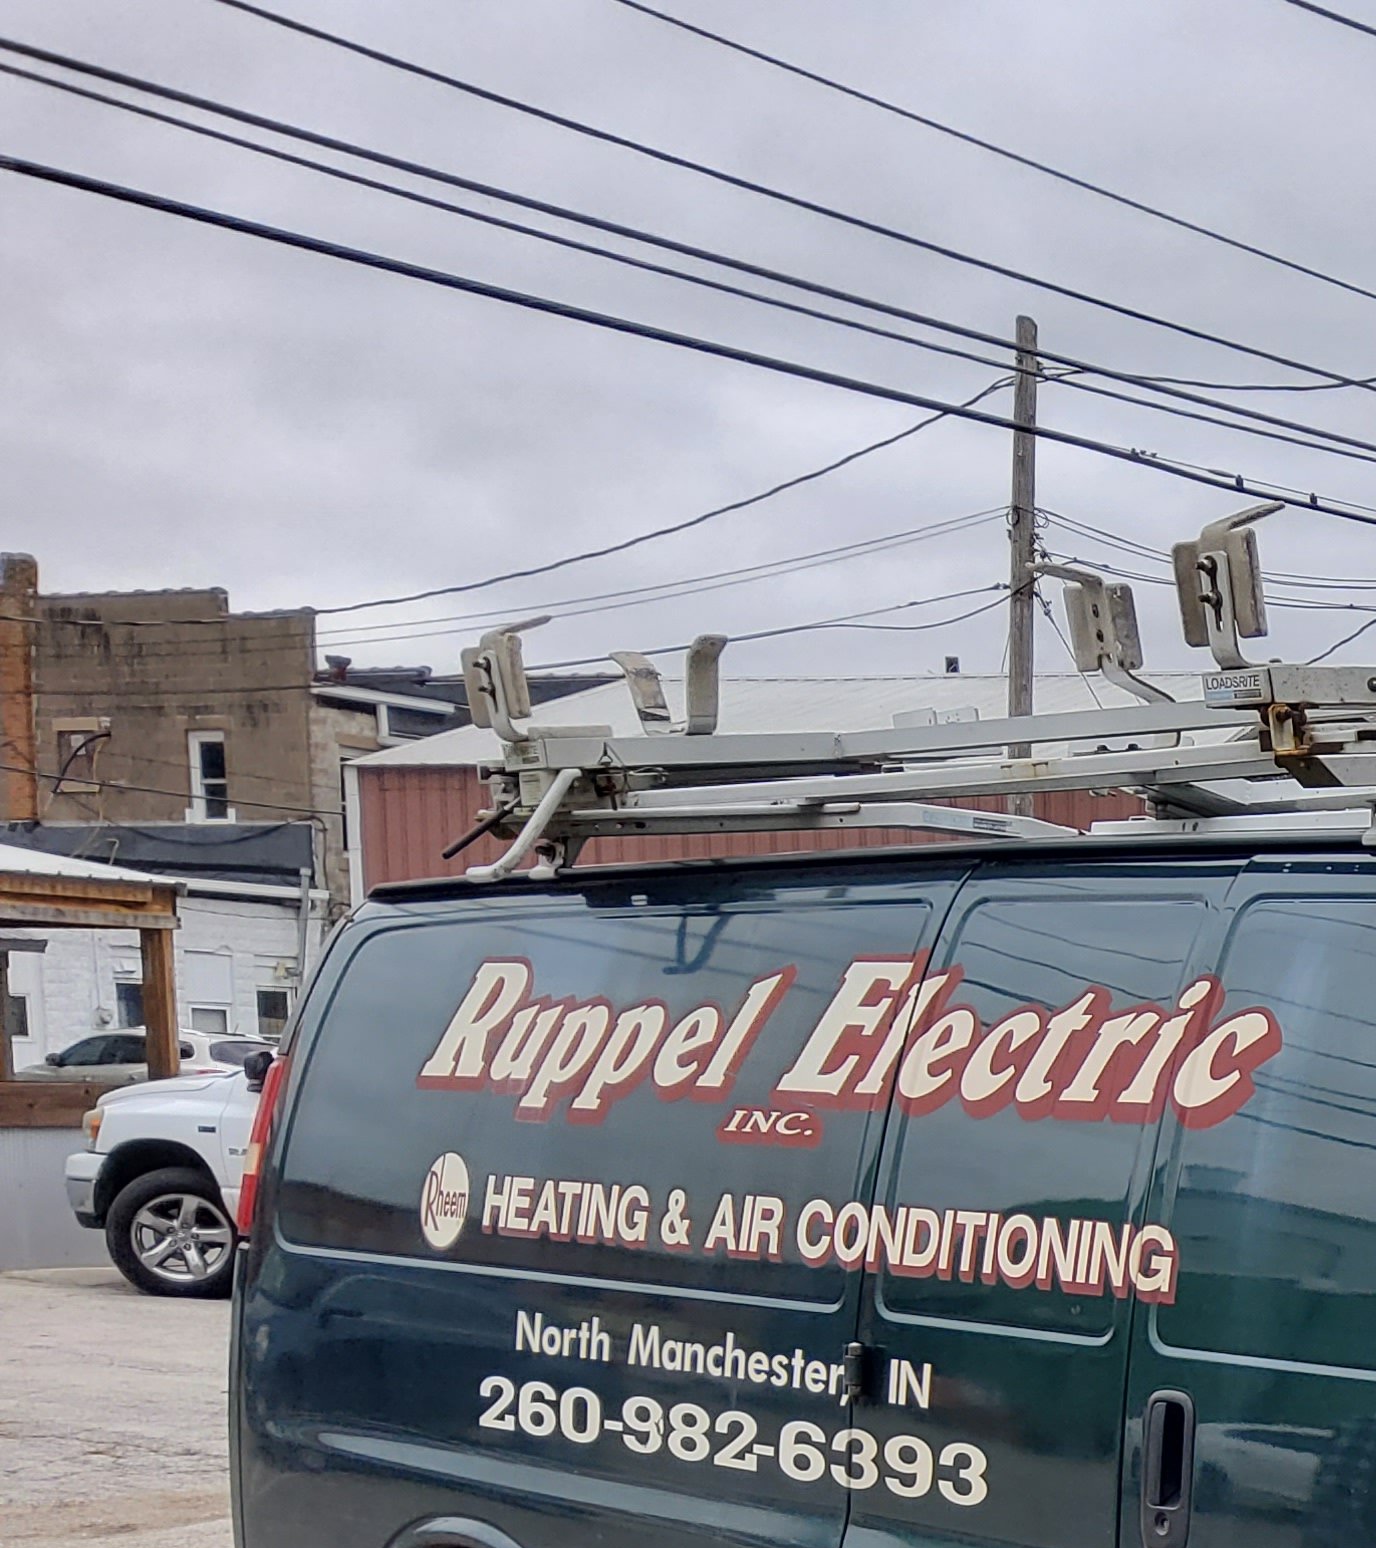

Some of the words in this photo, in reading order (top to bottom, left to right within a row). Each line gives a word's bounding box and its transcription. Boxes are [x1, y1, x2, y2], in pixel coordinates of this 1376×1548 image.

[1205, 674, 1260, 690] LOADSRITE
[419, 960, 784, 1114] Ruppel
[778, 960, 1272, 1110] Electric
[722, 1109, 814, 1137] INC.
[424, 1153, 468, 1232] Rheem
[483, 1175, 651, 1243] HEATING
[660, 1188, 691, 1240] &
[706, 1194, 782, 1257] AIR
[796, 1200, 1175, 1294] CONDITIONING
[514, 1310, 611, 1364] North
[627, 1323, 850, 1407] Manchester,
[887, 1357, 933, 1410] IN
[478, 1374, 989, 1507] 260-982-6393
